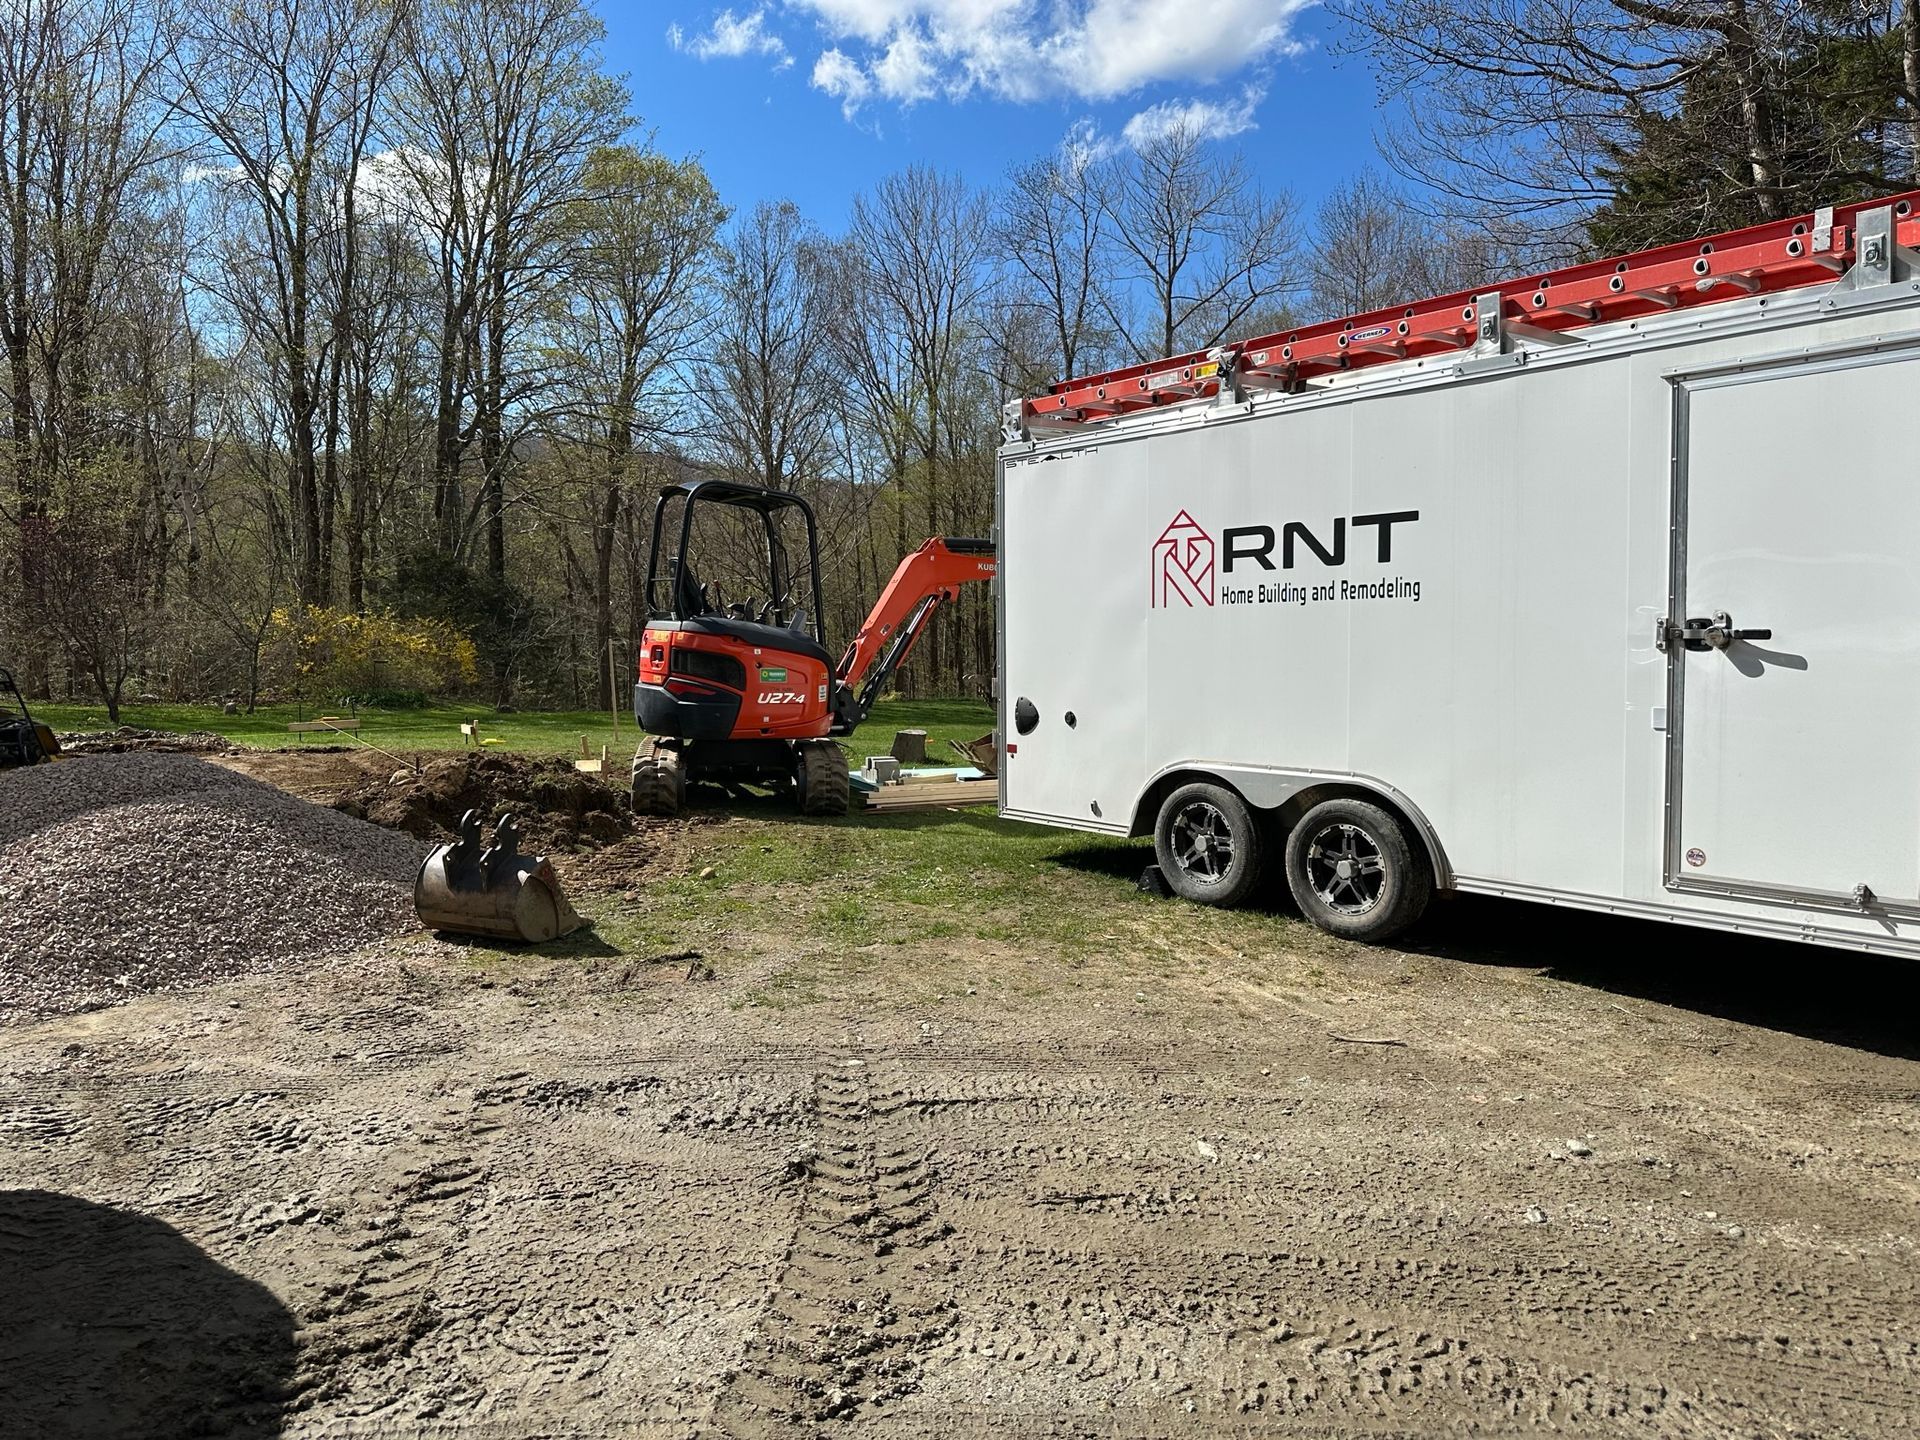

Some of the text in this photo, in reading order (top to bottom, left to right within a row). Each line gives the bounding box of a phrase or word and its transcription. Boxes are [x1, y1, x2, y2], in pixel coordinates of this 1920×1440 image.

[1357, 329, 1383, 339] WERNER
[1222, 510, 1419, 573] RNT
[1221, 576, 1421, 606] Home Building and Remodeling
[757, 692, 805, 704] U27-4
